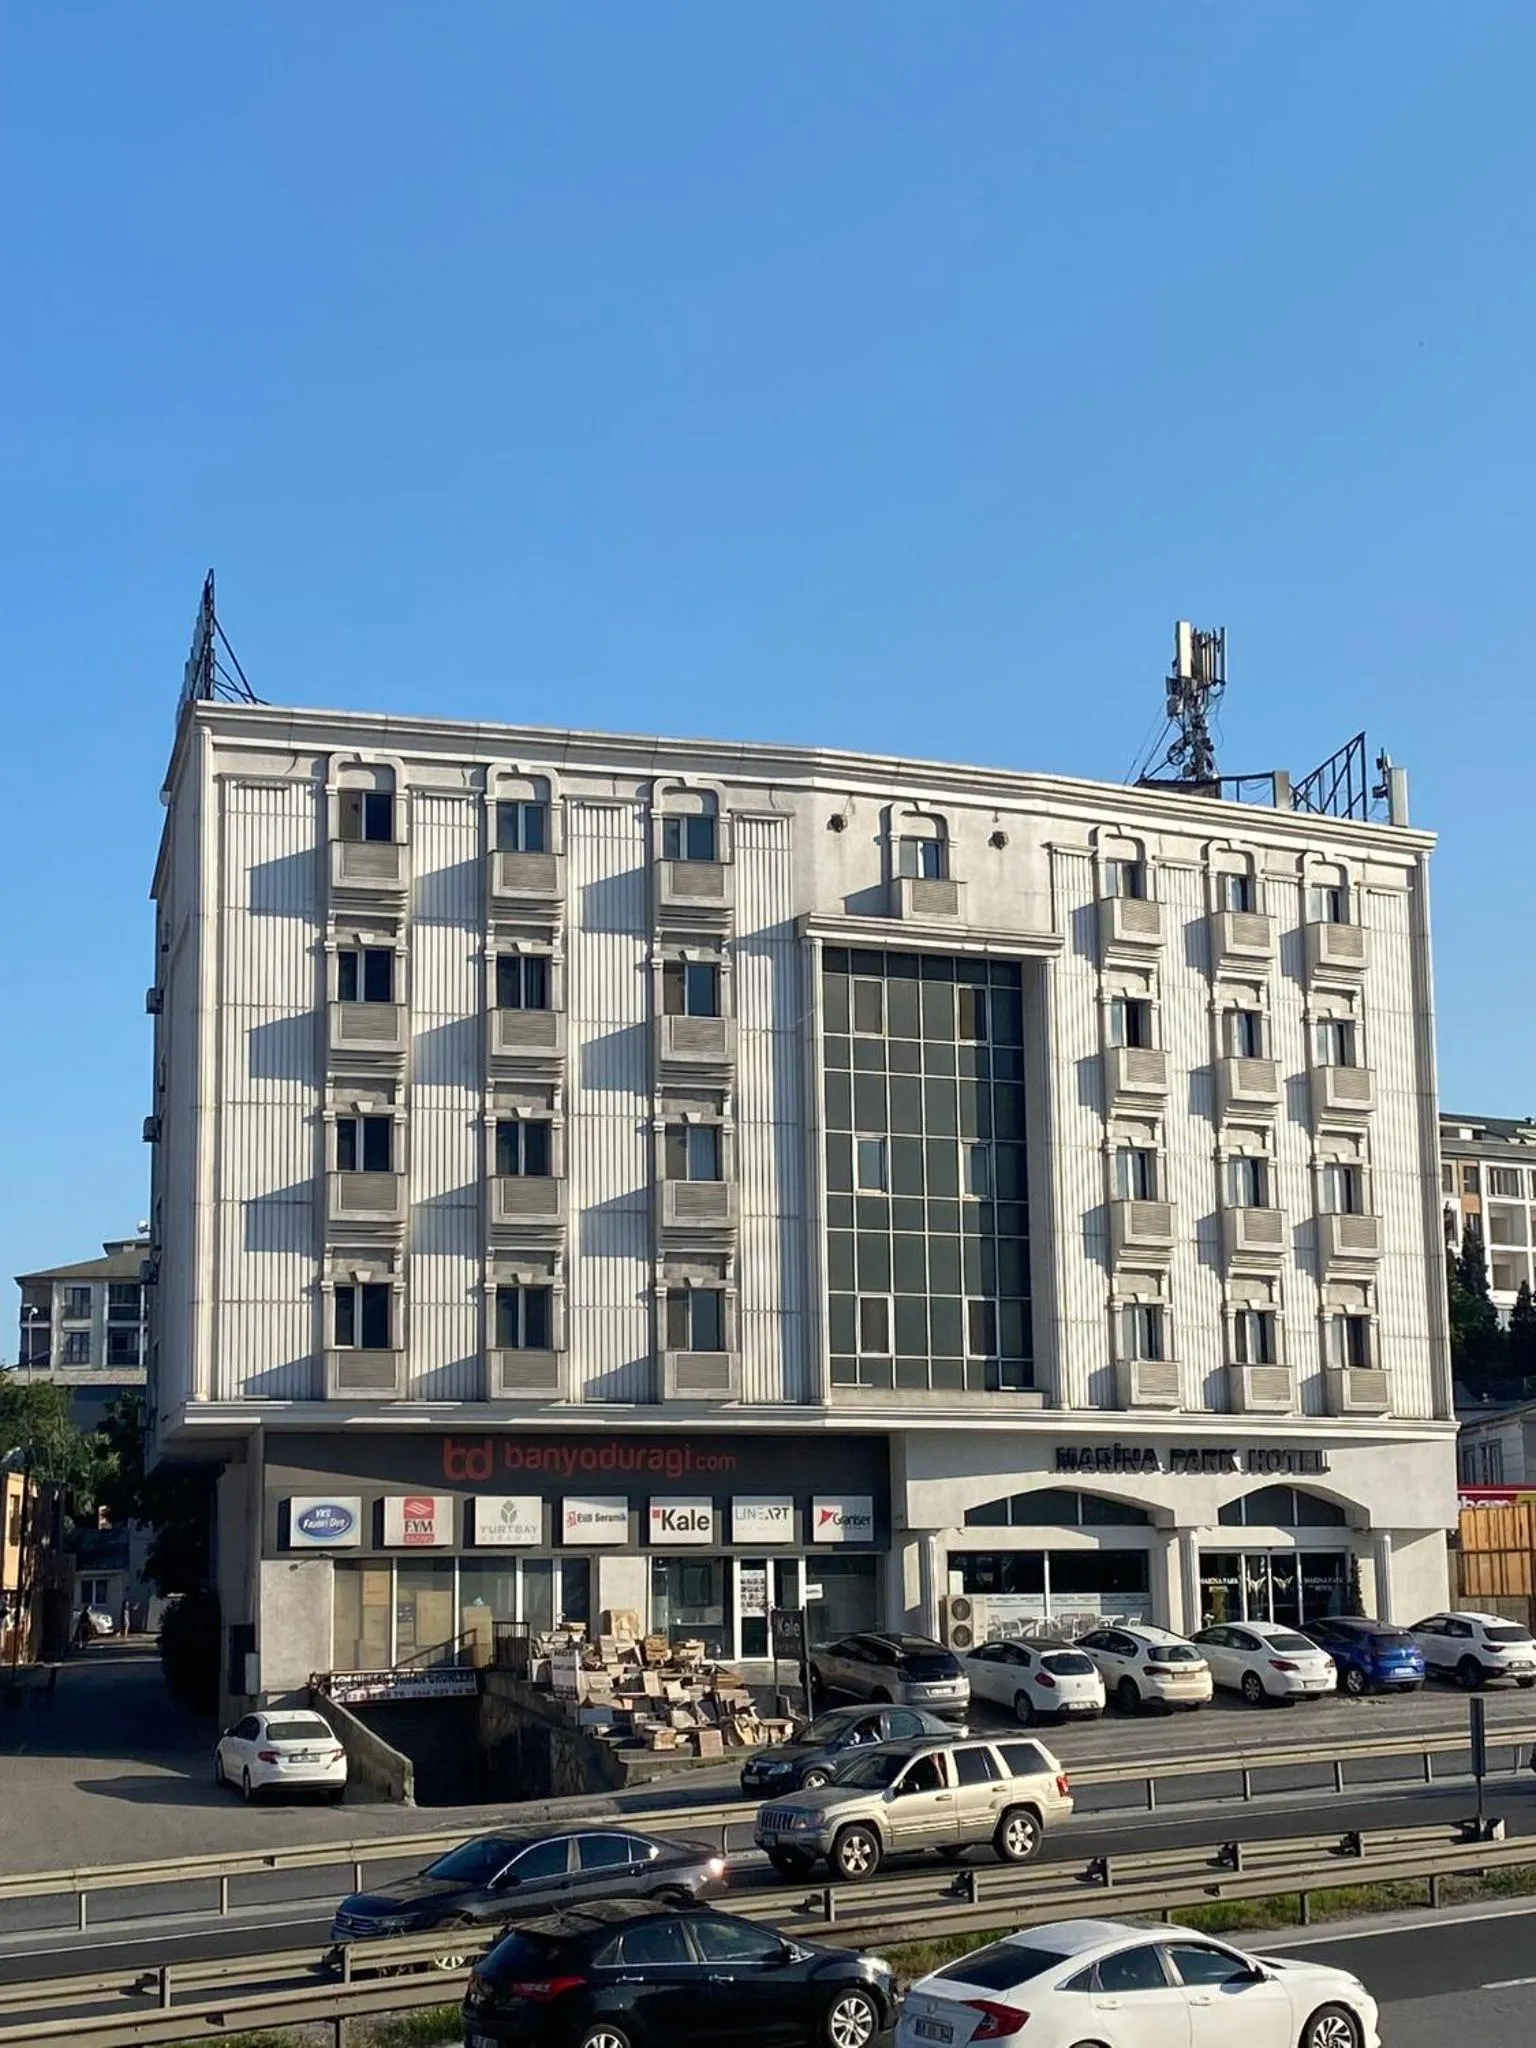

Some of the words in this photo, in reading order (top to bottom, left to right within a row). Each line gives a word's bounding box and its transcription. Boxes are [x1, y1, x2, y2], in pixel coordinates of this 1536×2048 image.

[1169, 1448, 1239, 1472] PARK
[1248, 1449, 1330, 1473] HOTEL
[662, 1508, 710, 1531] Kale
[777, 1616, 801, 1638] Kale
